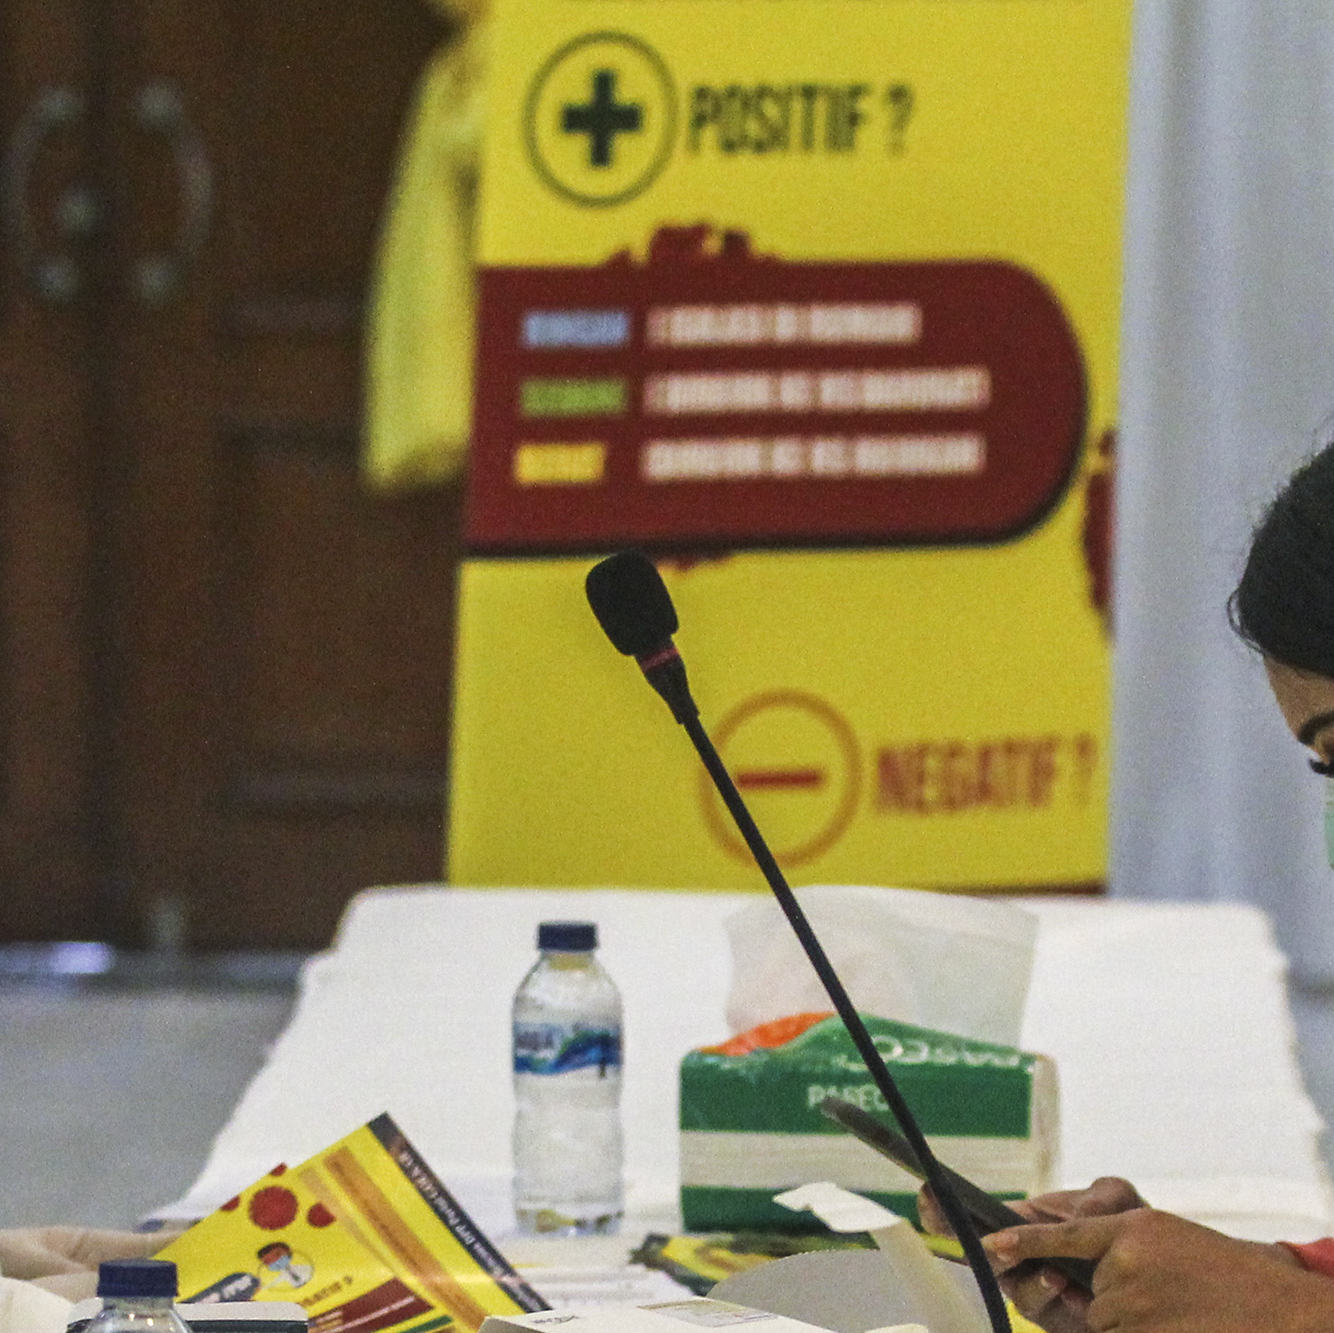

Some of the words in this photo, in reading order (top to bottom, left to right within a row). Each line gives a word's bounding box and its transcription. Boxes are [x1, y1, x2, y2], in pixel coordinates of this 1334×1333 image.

[687, 82, 873, 156] POSITIF
[886, 83, 916, 158] ?
[874, 734, 1060, 814] NEGATIF
